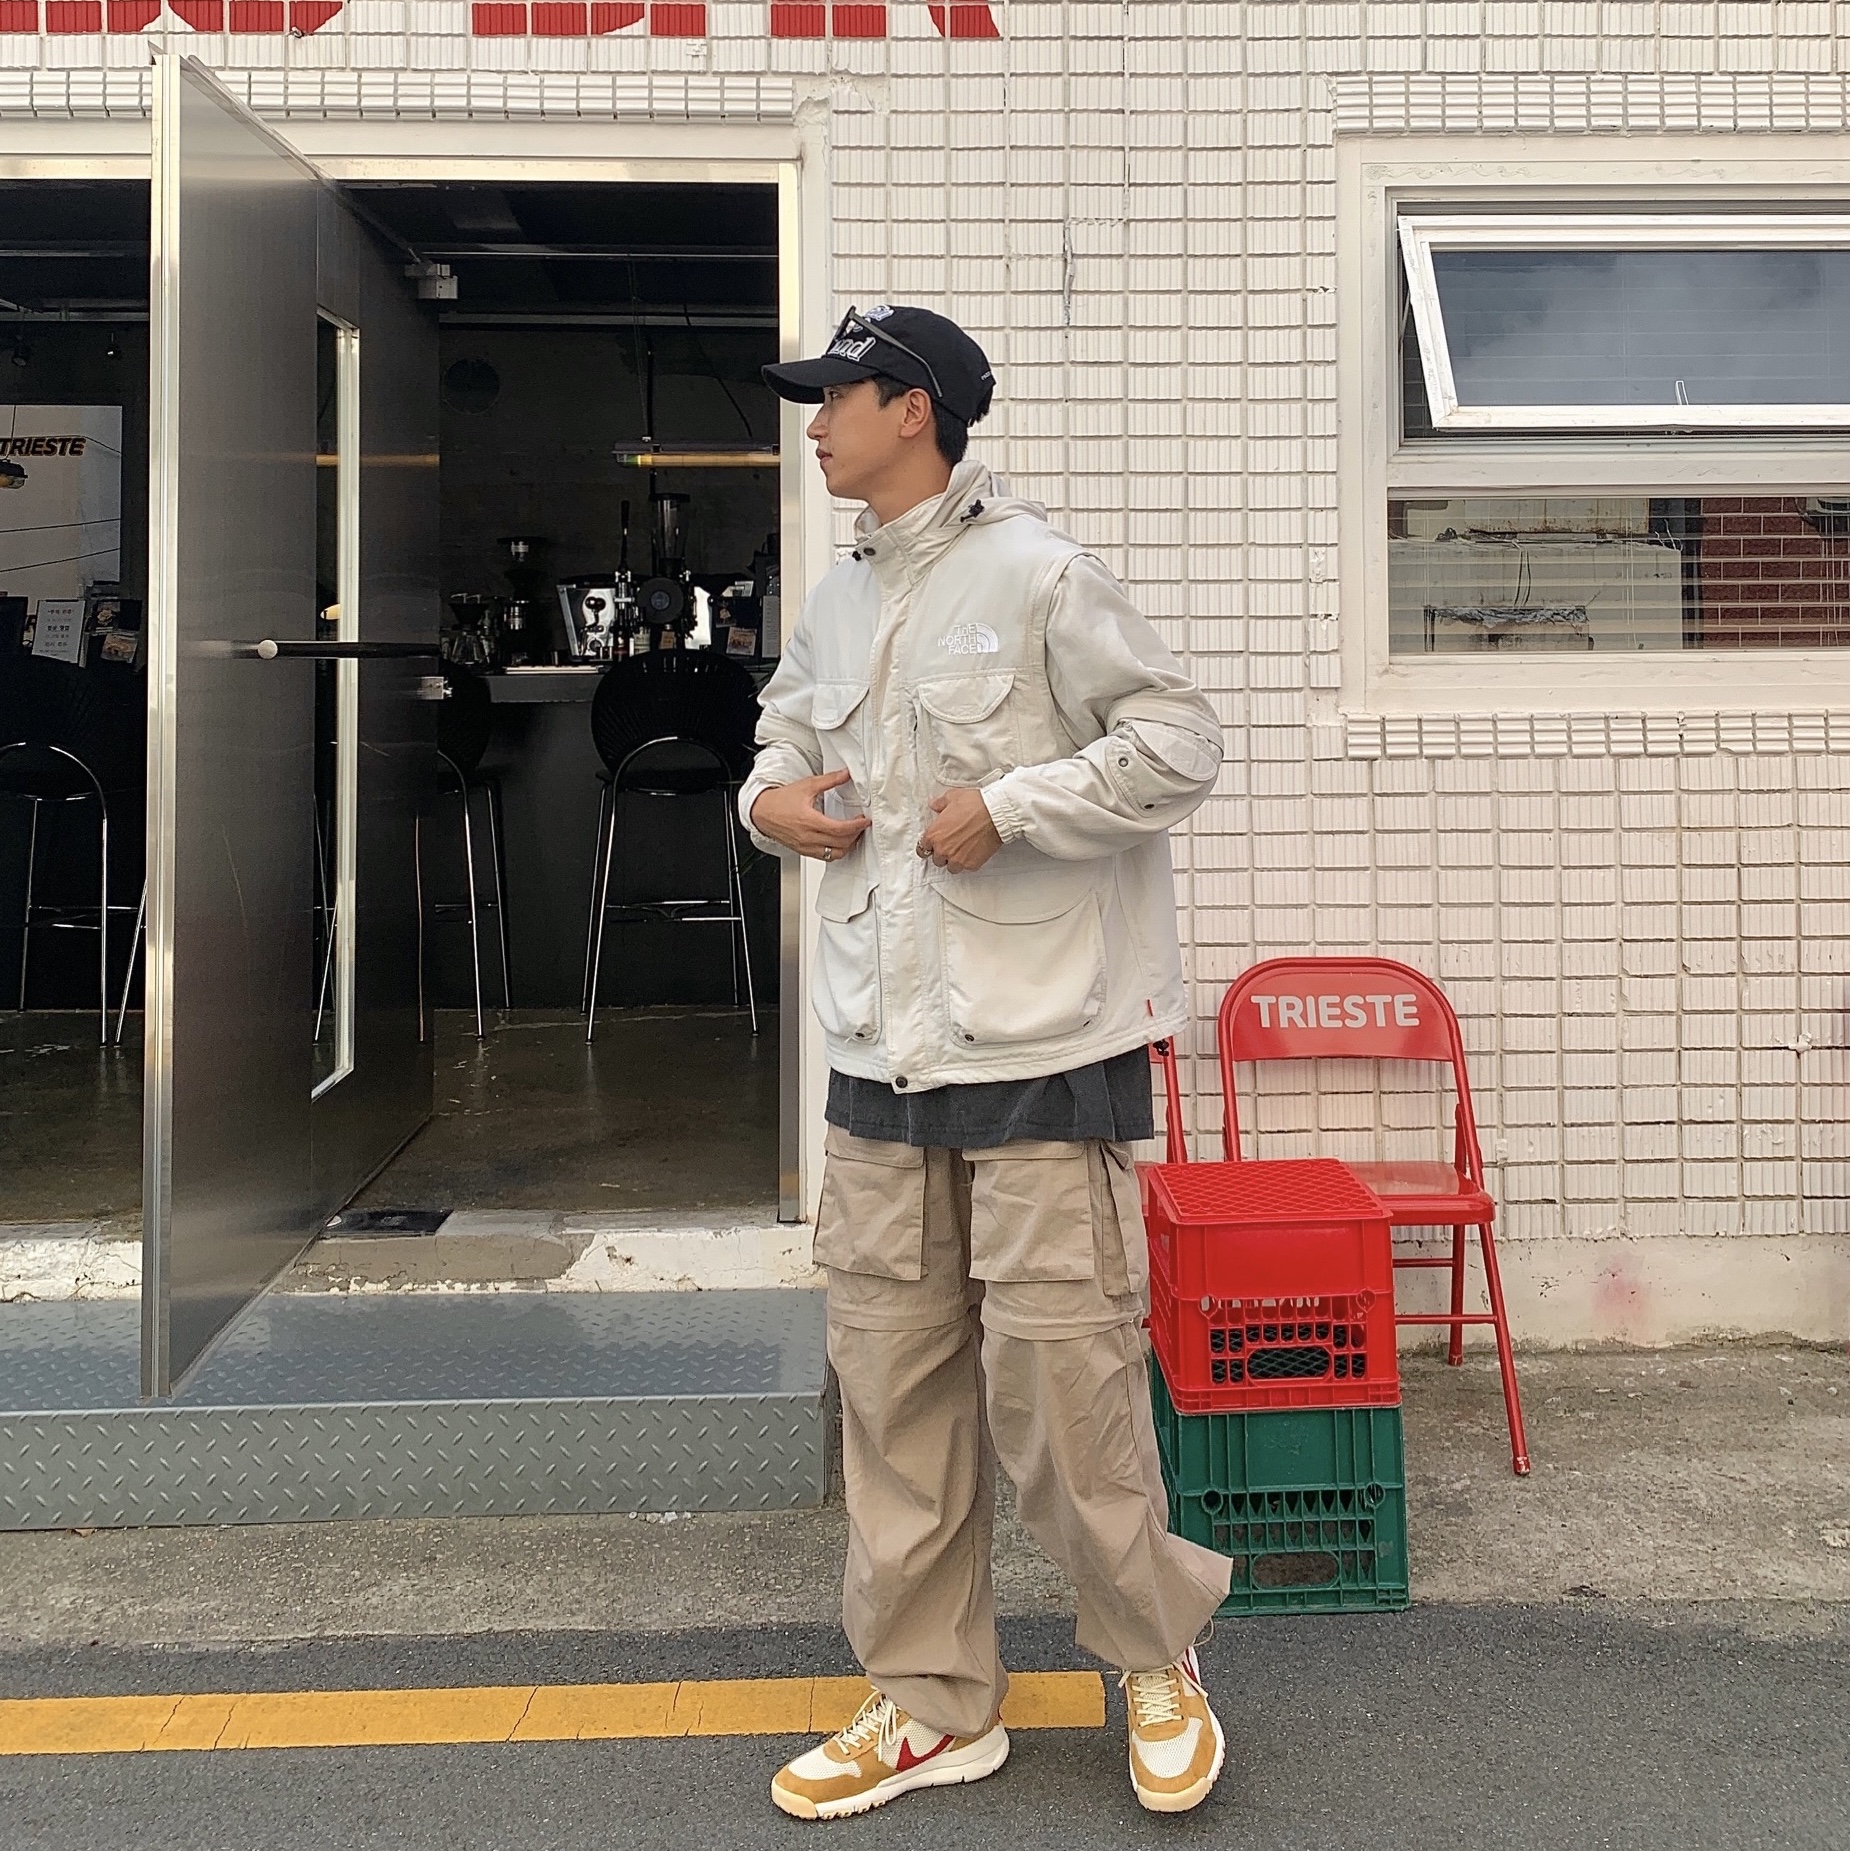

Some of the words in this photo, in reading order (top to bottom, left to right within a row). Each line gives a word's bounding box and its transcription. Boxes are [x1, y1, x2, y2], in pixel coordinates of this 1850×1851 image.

[0, 437, 86, 456] TRIESTE
[954, 623, 976, 635] THE
[937, 634, 976, 647] NORTH
[948, 644, 977, 655] FACE
[1250, 994, 1420, 1028] TRIESTE
